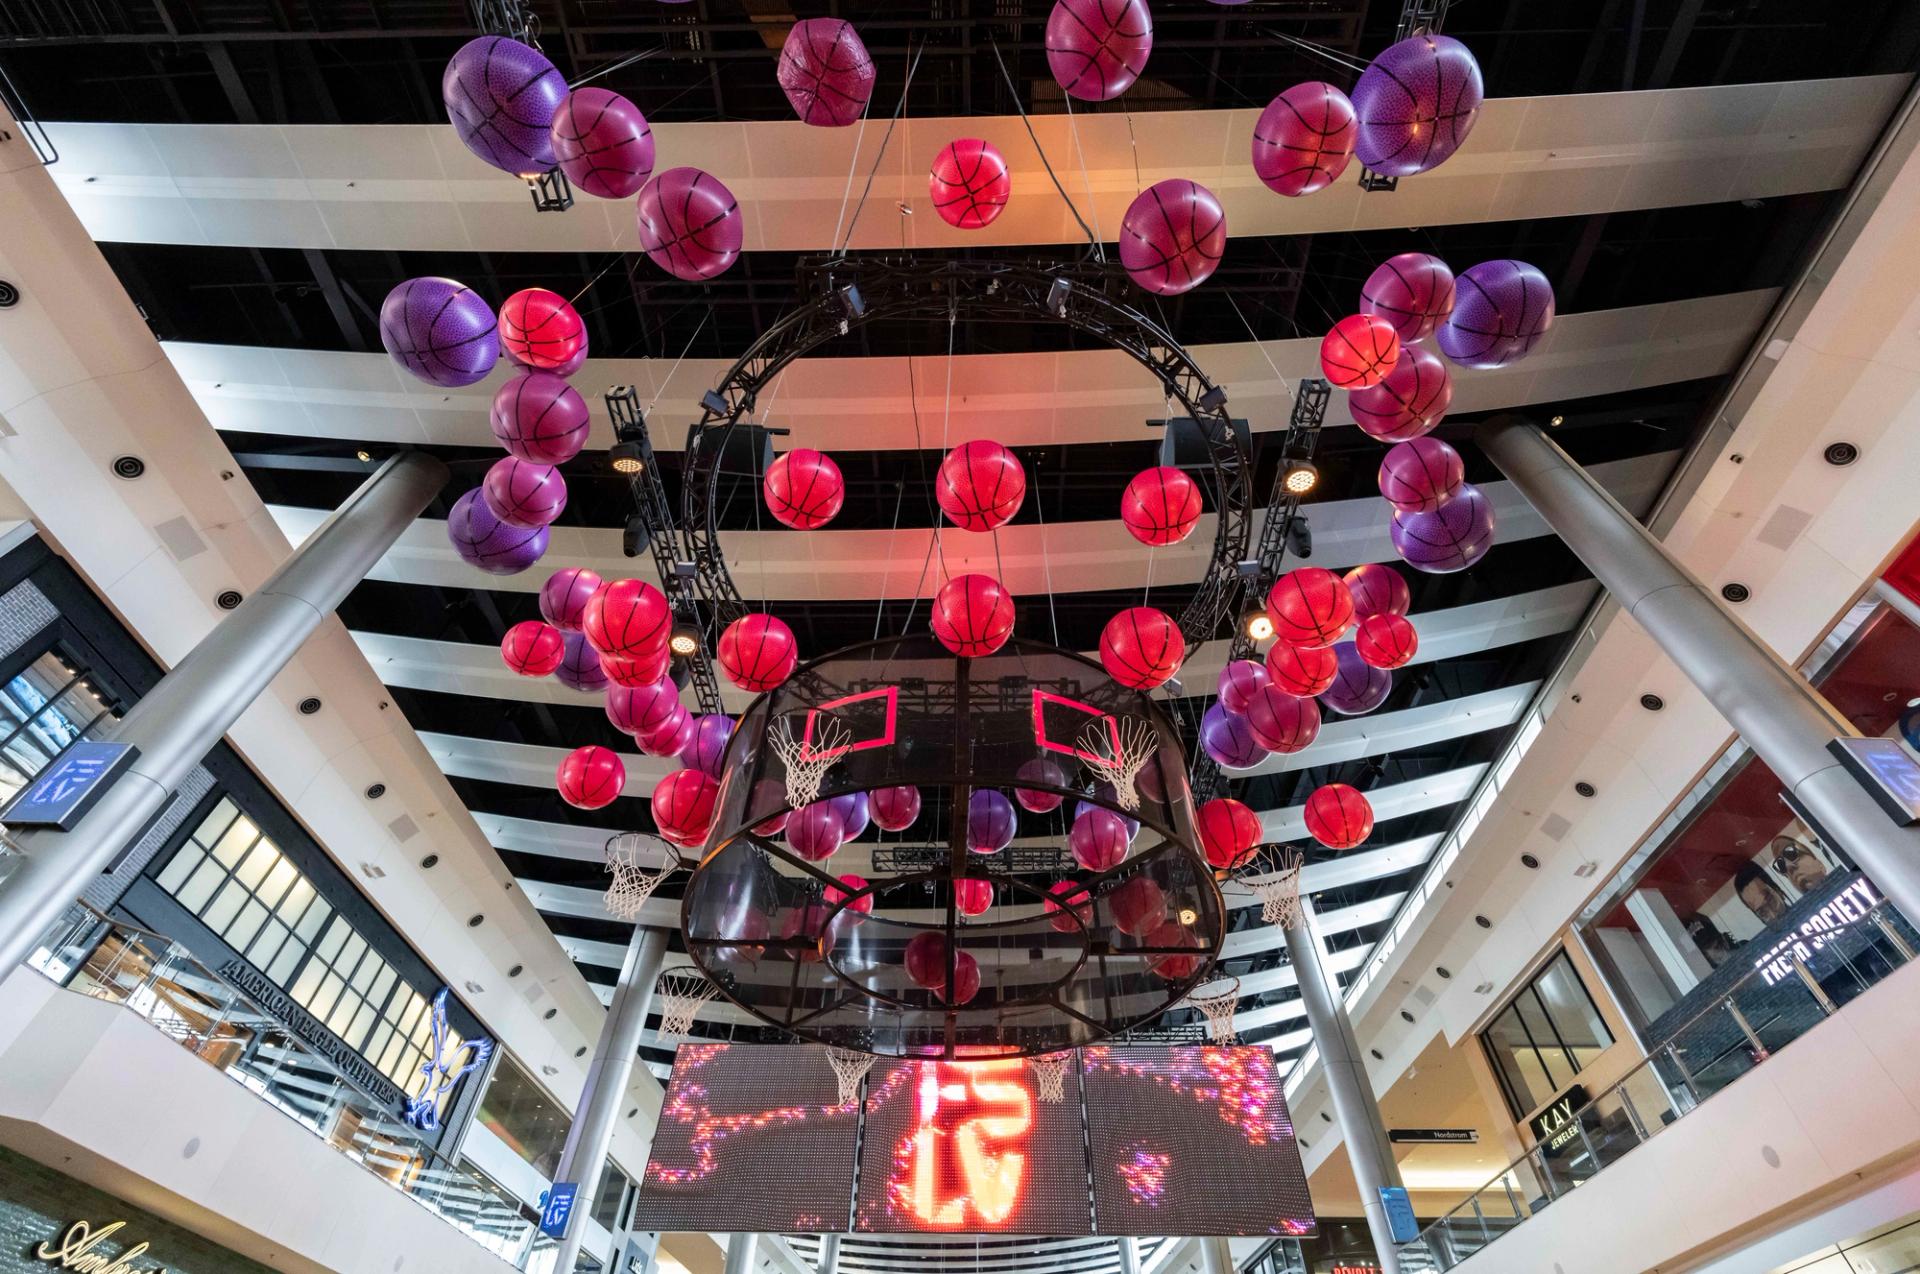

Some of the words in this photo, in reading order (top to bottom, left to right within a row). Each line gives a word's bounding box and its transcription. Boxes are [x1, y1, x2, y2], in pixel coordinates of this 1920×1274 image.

[1754, 932, 1812, 986] FREH
[1800, 878, 1878, 950] SOCIETY
[216, 960, 302, 1027] AMERICAN
[298, 1016, 339, 1059] EAGLE
[333, 1047, 399, 1105] OUTFITTERS
[1433, 1131, 1468, 1139] Nordstrom
[1540, 1098, 1573, 1138] KAY
[1551, 1124, 1581, 1150] JEWELER
